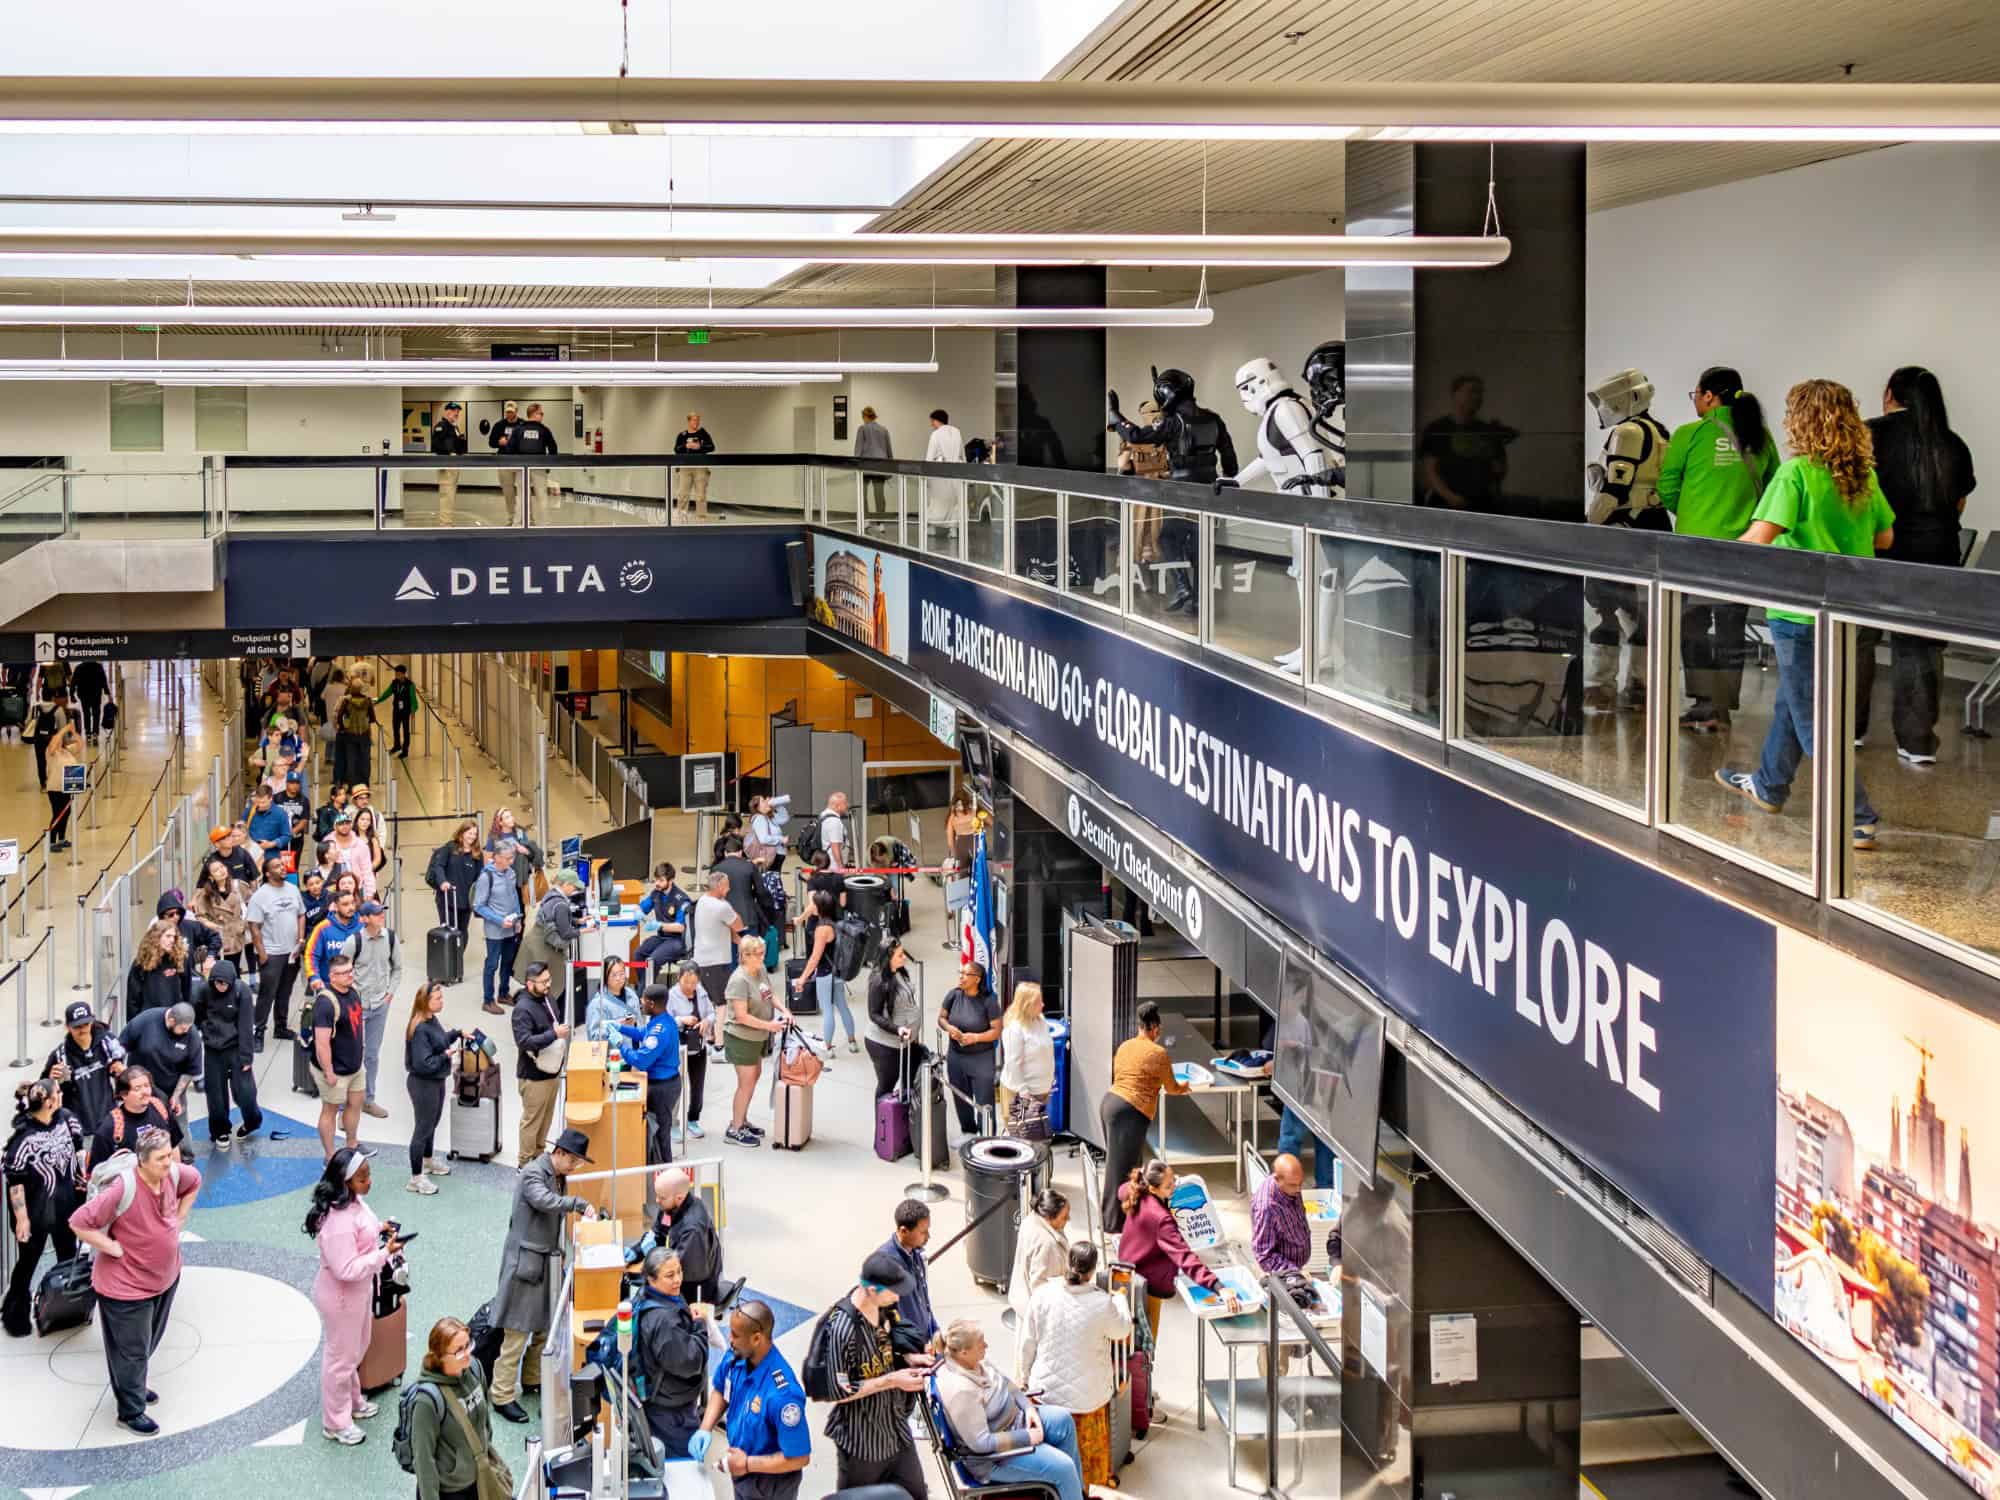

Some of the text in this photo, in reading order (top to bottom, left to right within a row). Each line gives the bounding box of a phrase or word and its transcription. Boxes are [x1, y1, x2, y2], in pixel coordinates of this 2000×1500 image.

[451, 565, 606, 595] DELTA
[69, 636, 114, 647] Checkpoints
[232, 633, 271, 644] Checkpoint
[69, 649, 109, 657] Restrooms
[246, 646, 278, 654] All Gates
[921, 600, 956, 664] ROME,
[956, 614, 1027, 696] BARCELONA
[1028, 646, 1059, 712] AND
[1061, 662, 1093, 727] 60+
[1095, 678, 1167, 779] GLOBAL
[1169, 714, 1362, 904] DESTINATIONS
[1367, 820, 1419, 940] TO
[1428, 852, 1661, 1112] EXPLORE
[1081, 809, 1121, 871] Security
[1122, 842, 1184, 921] Checkpoint
